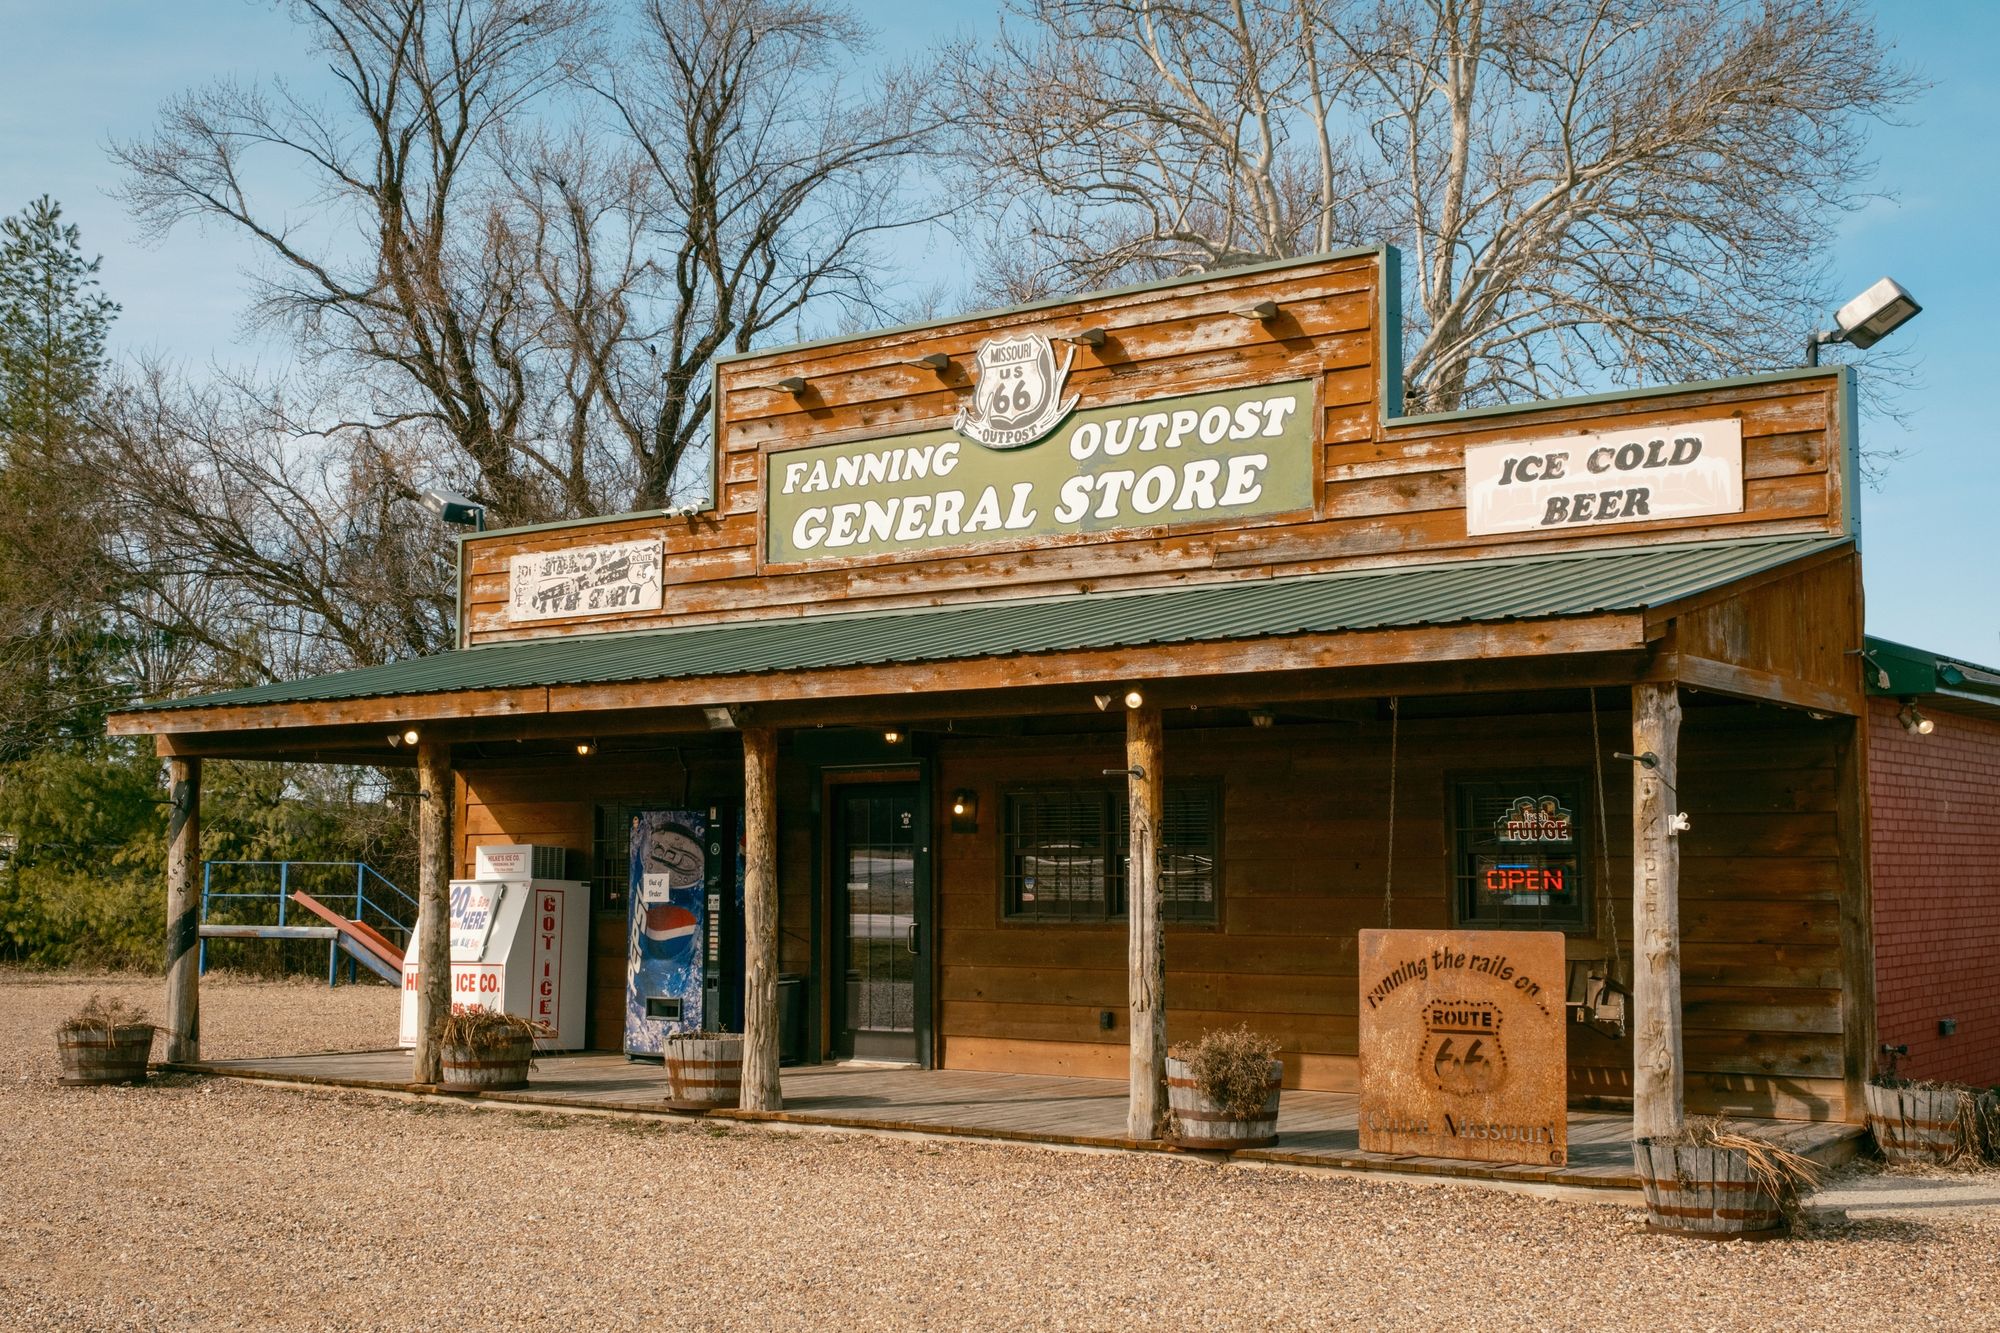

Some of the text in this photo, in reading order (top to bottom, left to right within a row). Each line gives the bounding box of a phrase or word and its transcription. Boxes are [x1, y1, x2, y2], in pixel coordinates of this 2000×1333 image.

[990, 342, 1032, 363] MISSOURI
[999, 366, 1023, 380] US
[992, 379, 1031, 414] 66
[982, 424, 1038, 444] OUTPOST
[781, 396, 1297, 495] FANNING OUTPOST
[1498, 437, 1702, 486] ICE COLD
[792, 453, 1268, 551] GENERAL STORE
[1540, 487, 1651, 526] BEER
[1523, 810, 1549, 822] fresh
[1507, 820, 1569, 841] FUDGE
[1486, 869, 1563, 890] OPEN
[450, 886, 472, 918] 20
[648, 890, 663, 898] Order
[460, 911, 488, 930] HERE
[542, 895, 556, 951] GOT
[455, 973, 500, 992] ICE CO.
[1367, 957, 1429, 1009] running
[1431, 946, 1466, 970] the
[1468, 954, 1515, 980] rails
[1432, 1009, 1492, 1027] ROUTE
[1443, 1114, 1556, 1145] Missouri
